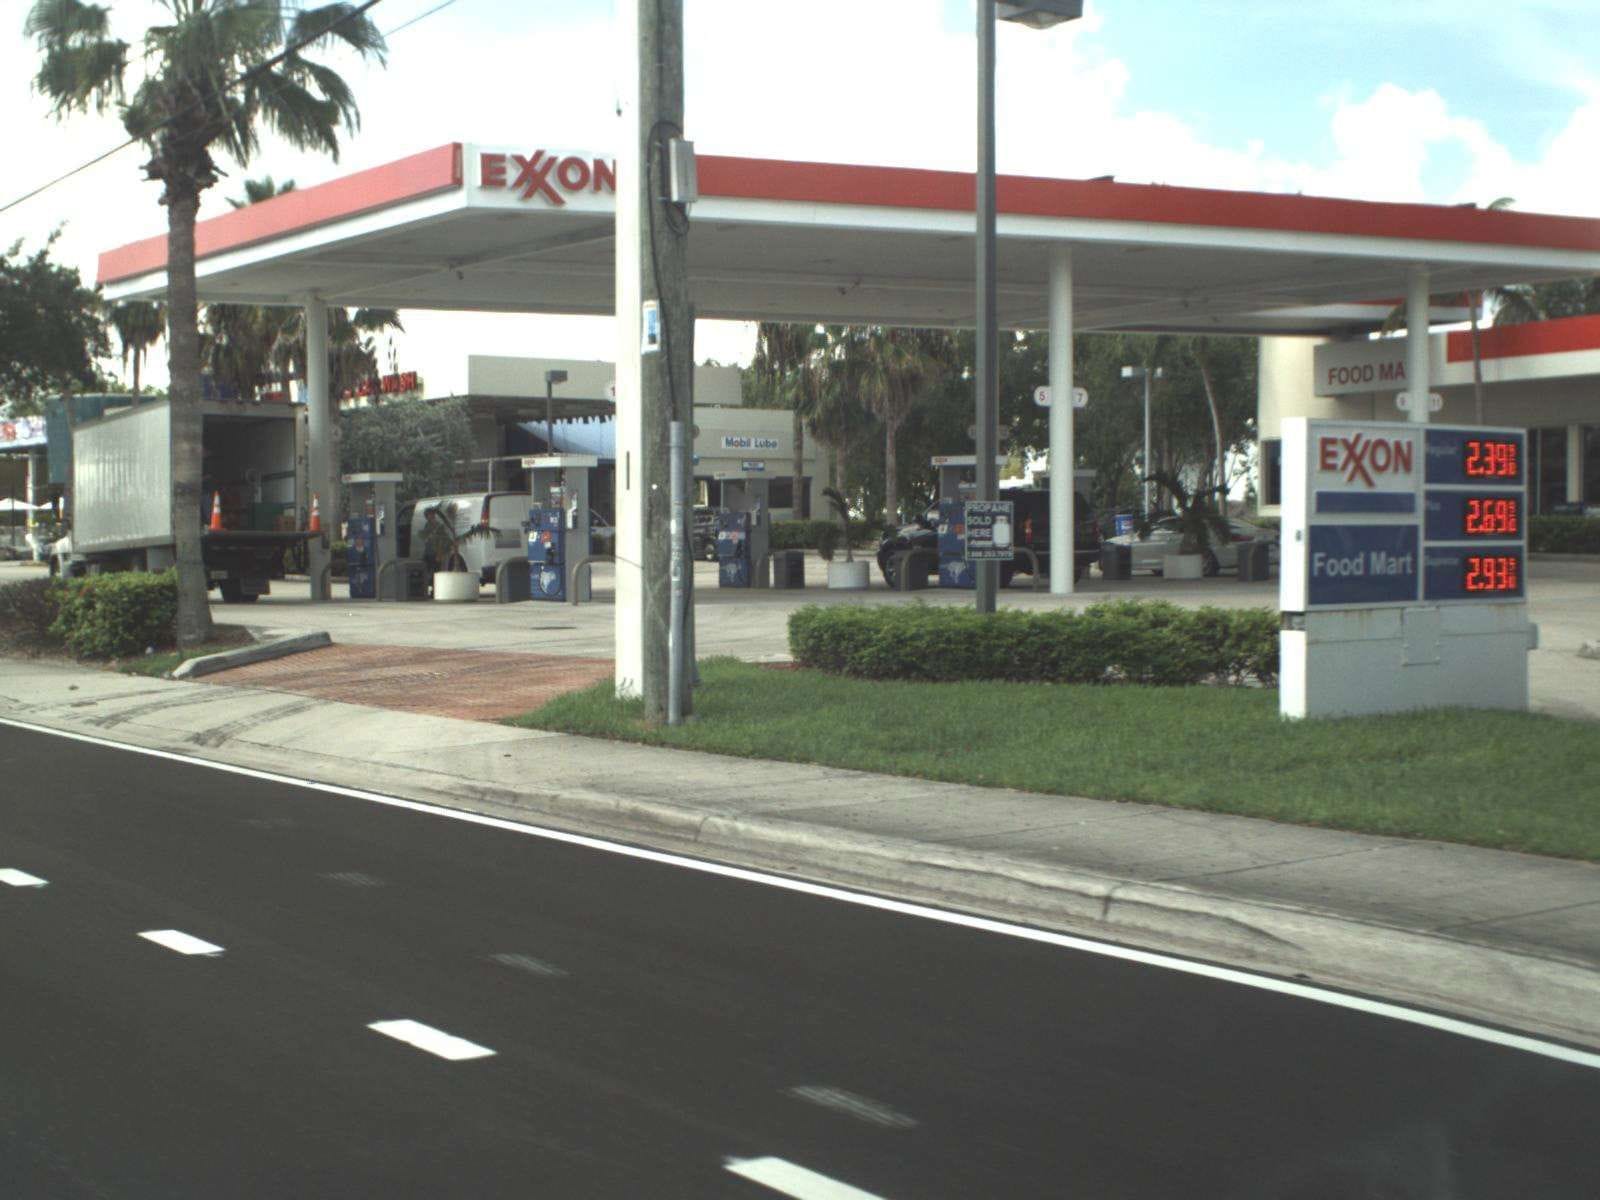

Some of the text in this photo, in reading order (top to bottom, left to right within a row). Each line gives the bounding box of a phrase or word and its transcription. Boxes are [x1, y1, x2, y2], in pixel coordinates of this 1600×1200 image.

[480, 150, 616, 206] EXXON
[1328, 361, 1406, 385] FOOD MA
[725, 437, 751, 448] Mobil
[1319, 433, 1412, 487] EXXON
[967, 503, 1010, 512] PROPANE
[967, 515, 992, 525] SOLD
[967, 528, 993, 537] HERE
[1313, 551, 1413, 577] Food Mart
